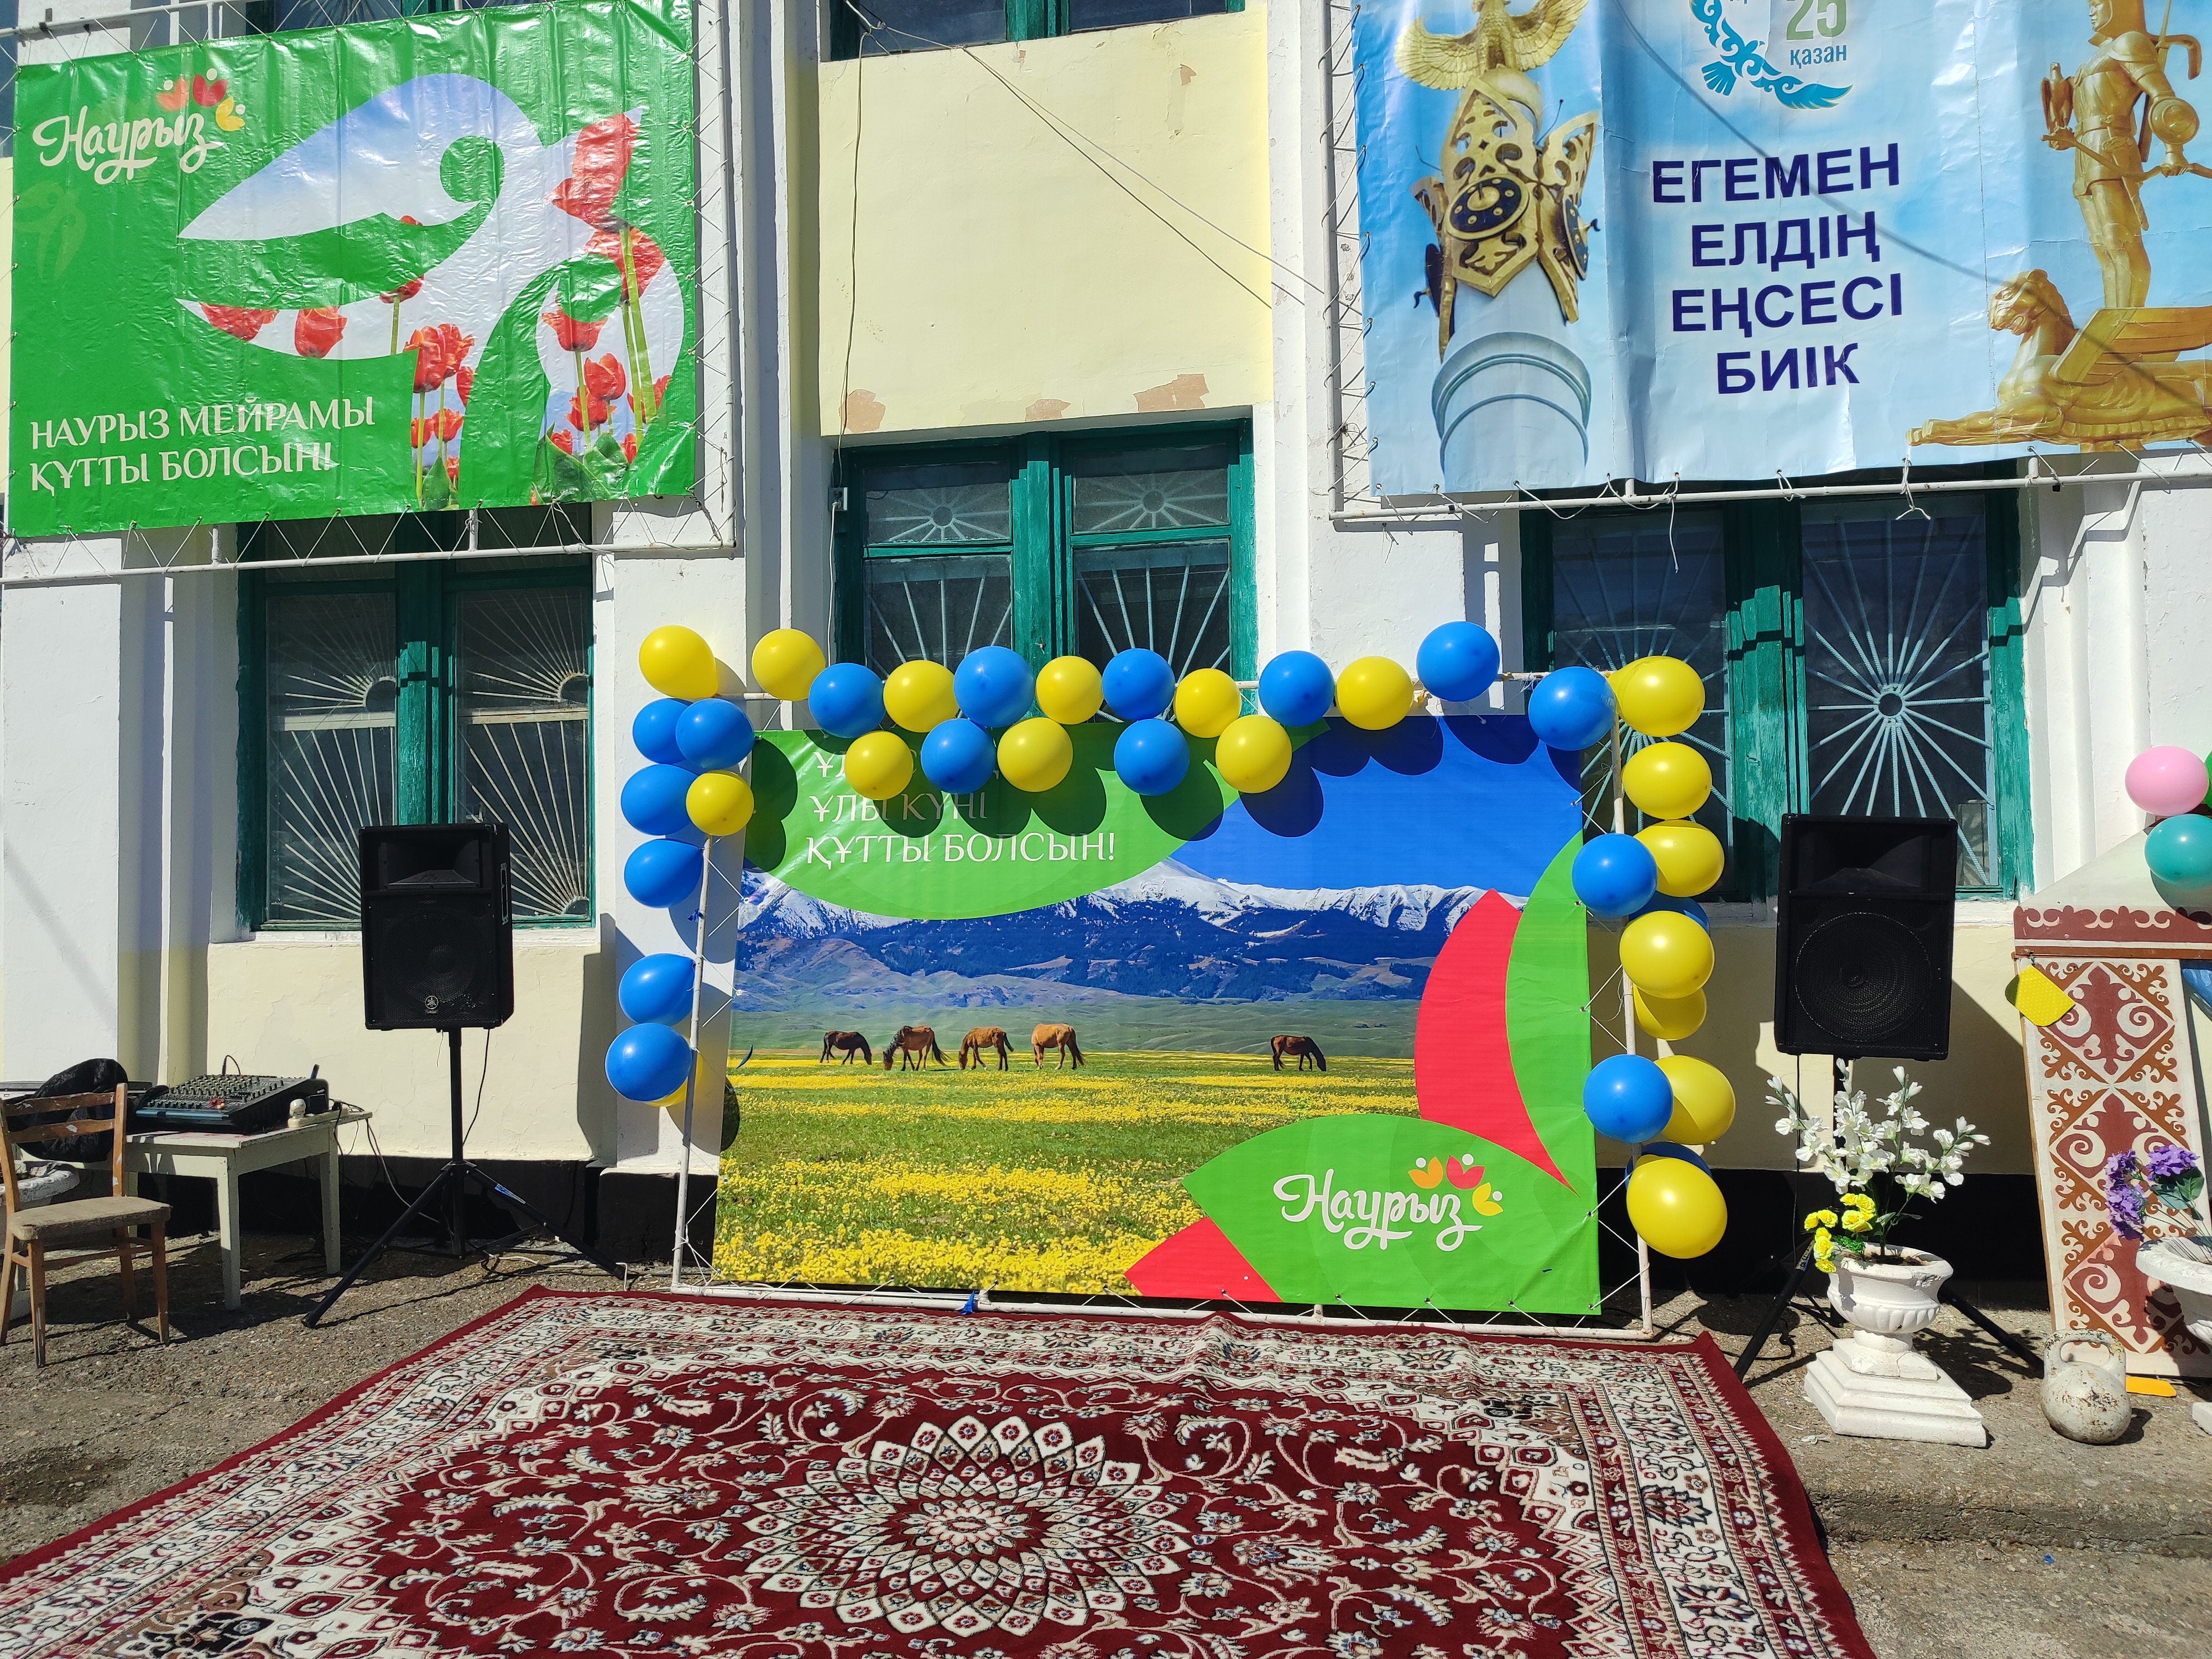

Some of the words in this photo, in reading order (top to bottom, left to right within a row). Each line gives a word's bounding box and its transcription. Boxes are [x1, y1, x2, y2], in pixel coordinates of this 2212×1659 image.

[1786, 0, 1847, 40] 25
[1790, 45, 1847, 69] қазан
[32, 105, 223, 185] Наурыз
[1652, 143, 1899, 203] ЕГЕМЕН
[1692, 211, 1880, 272] ЕЛДІҢ
[1672, 273, 1902, 338] ЕҢСЕСІ
[1717, 343, 1860, 394] БИІК
[30, 408, 170, 450] НАУРЫЗ
[180, 397, 375, 437] МЕЙРАМЫ
[30, 453, 150, 496] ҚҰТТЫ
[159, 442, 331, 481] БОЛСЫН!
[808, 793, 889, 823] ҰЛЫ
[901, 792, 988, 820] КҮНІ
[807, 834, 931, 870] ҚҰТТЫ
[944, 832, 1115, 862] БОЛСЫН!
[1273, 1168, 1483, 1252] Наурыз
